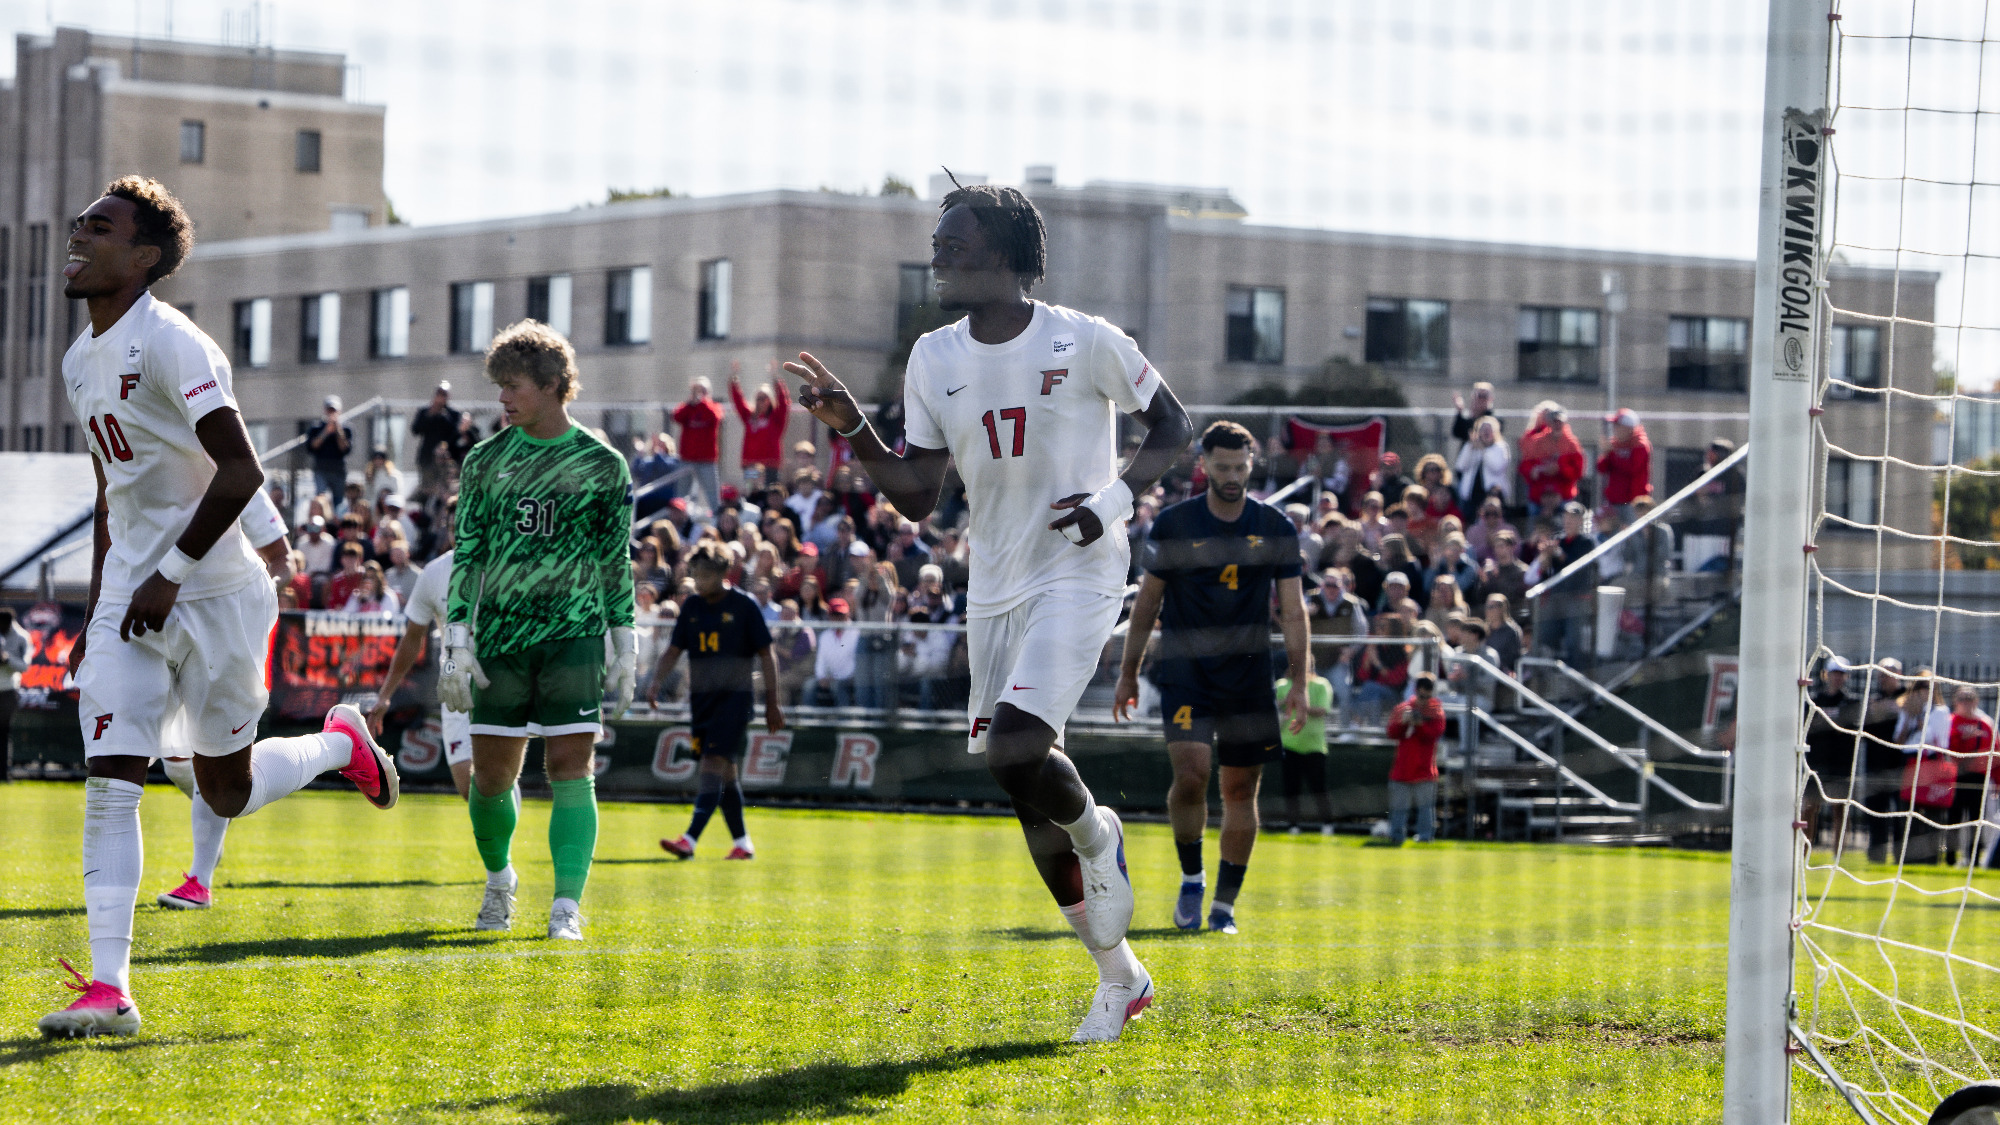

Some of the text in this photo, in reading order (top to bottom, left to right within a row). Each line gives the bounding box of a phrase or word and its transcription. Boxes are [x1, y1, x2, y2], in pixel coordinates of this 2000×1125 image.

[118, 373, 141, 400] F
[184, 380, 217, 400] METRO
[1039, 368, 1069, 396] F
[89, 413, 134, 464] 10
[981, 406, 1026, 460] 17
[516, 497, 555, 537] 31
[1219, 564, 1239, 590] 4
[699, 631, 719, 653] 14
[93, 713, 113, 740] F
[970, 717, 992, 738] F
[1173, 705, 1193, 730] 4
